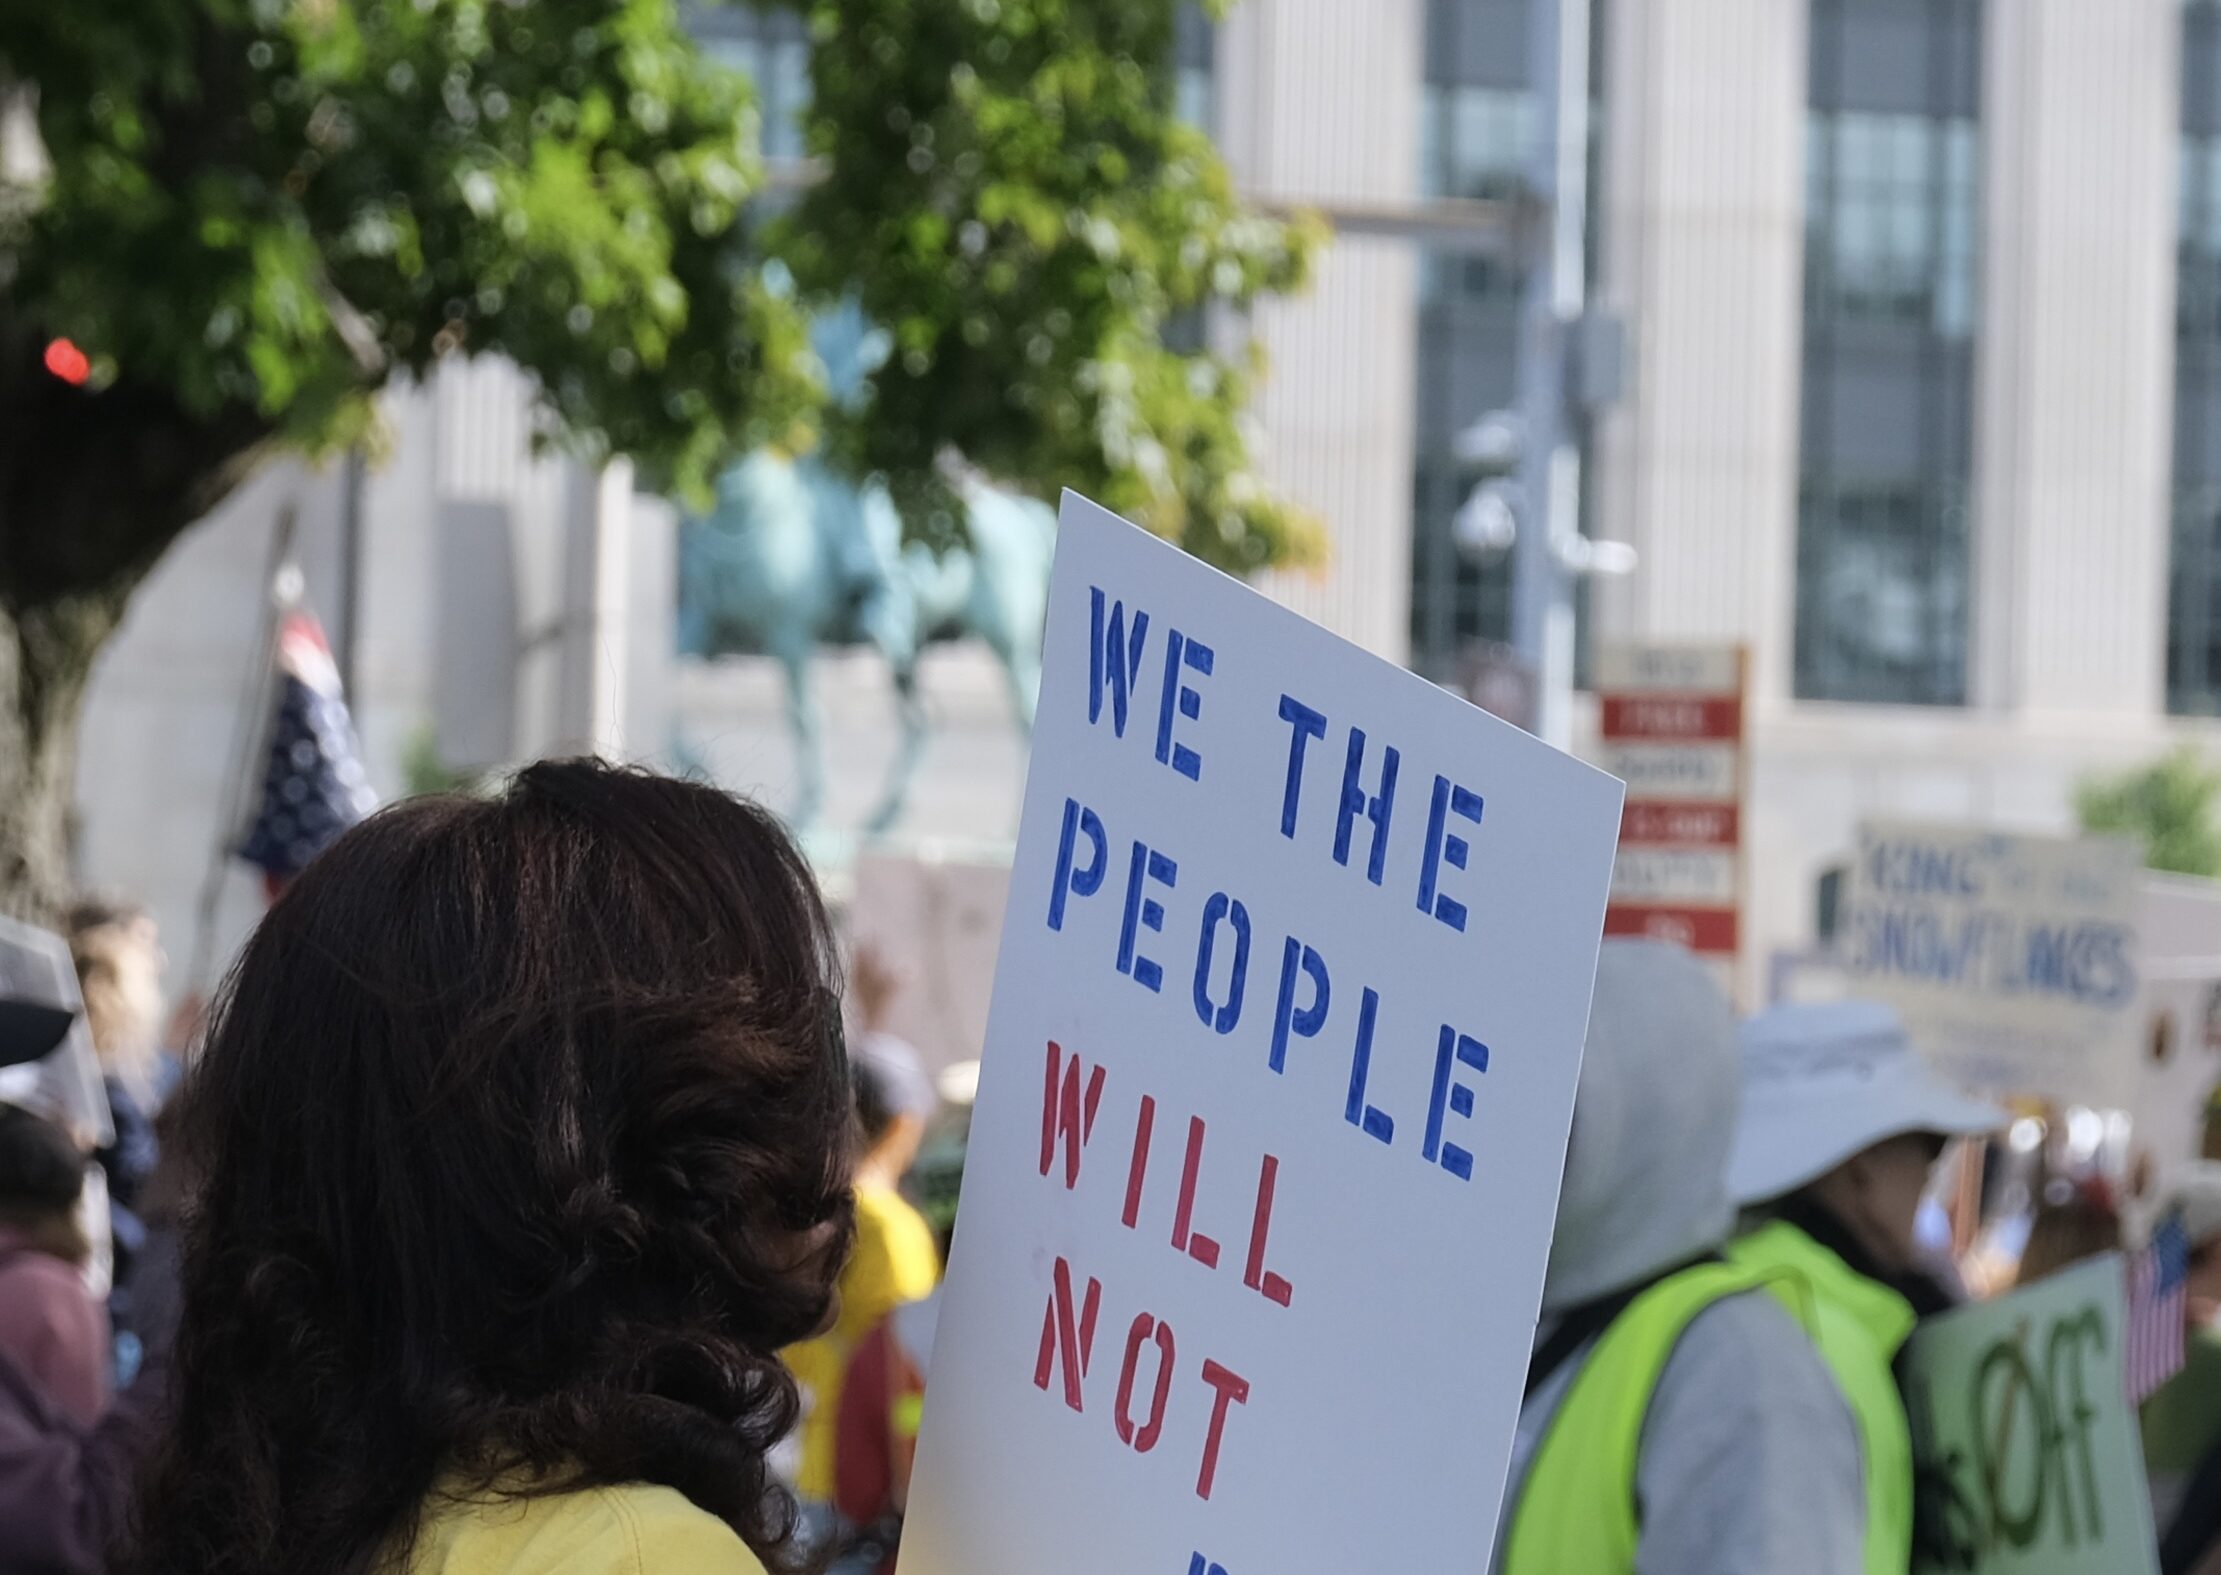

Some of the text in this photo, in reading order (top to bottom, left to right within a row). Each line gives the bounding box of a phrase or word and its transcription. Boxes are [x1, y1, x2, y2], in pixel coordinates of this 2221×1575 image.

[1088, 585, 1485, 933] WE THE
[1047, 797, 1490, 1182] PEOPLE
[1039, 1040, 1293, 1308] WILL
[1033, 1255, 1250, 1501] NOT
